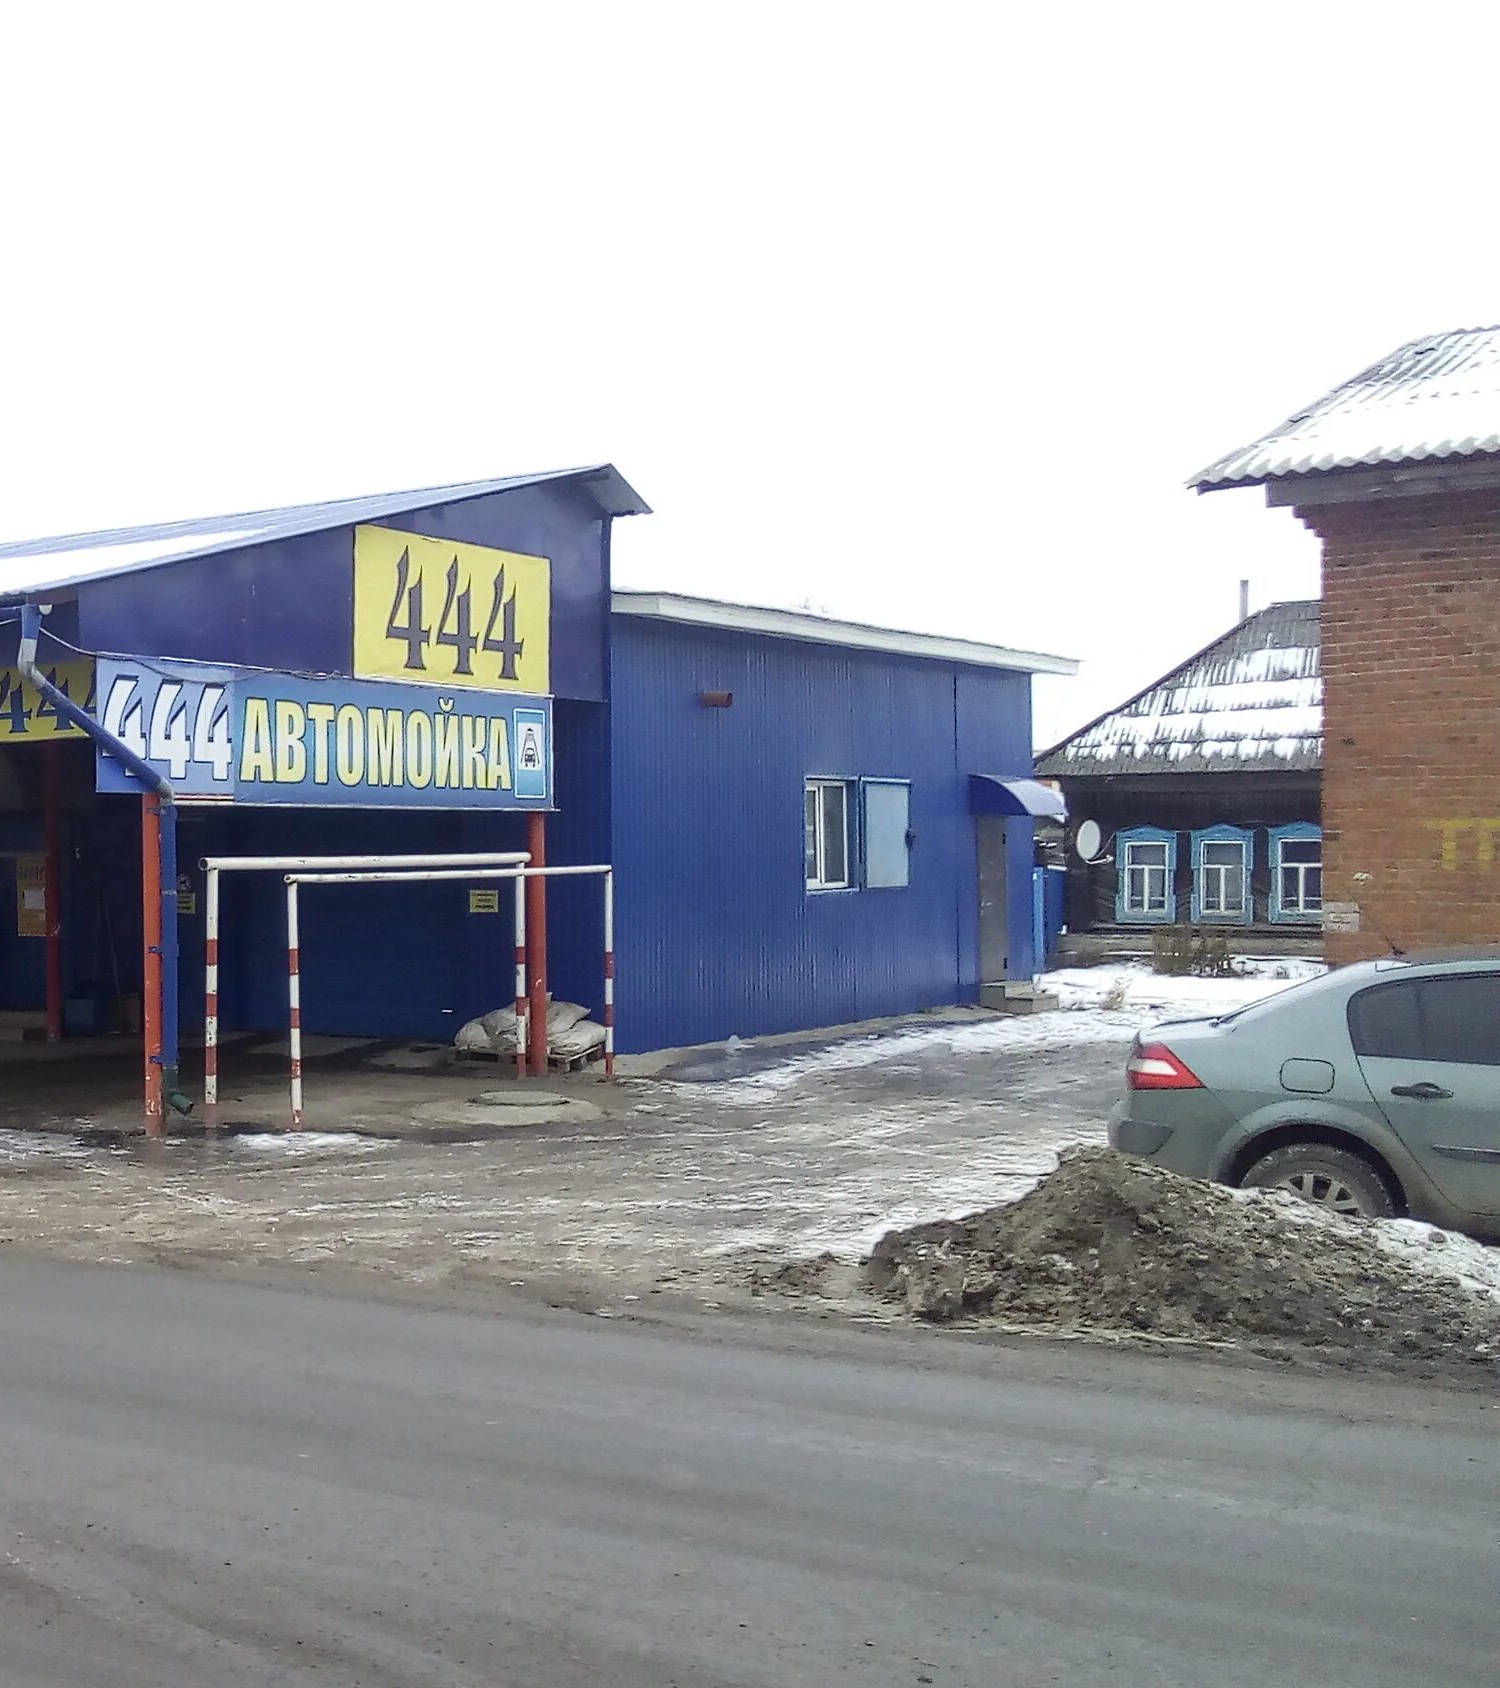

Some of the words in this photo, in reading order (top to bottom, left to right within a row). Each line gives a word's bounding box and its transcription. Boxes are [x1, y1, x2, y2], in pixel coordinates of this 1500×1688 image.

[385, 545, 525, 681] 444
[102, 674, 233, 782] 444
[239, 697, 513, 791] АВТОМОЙКА
